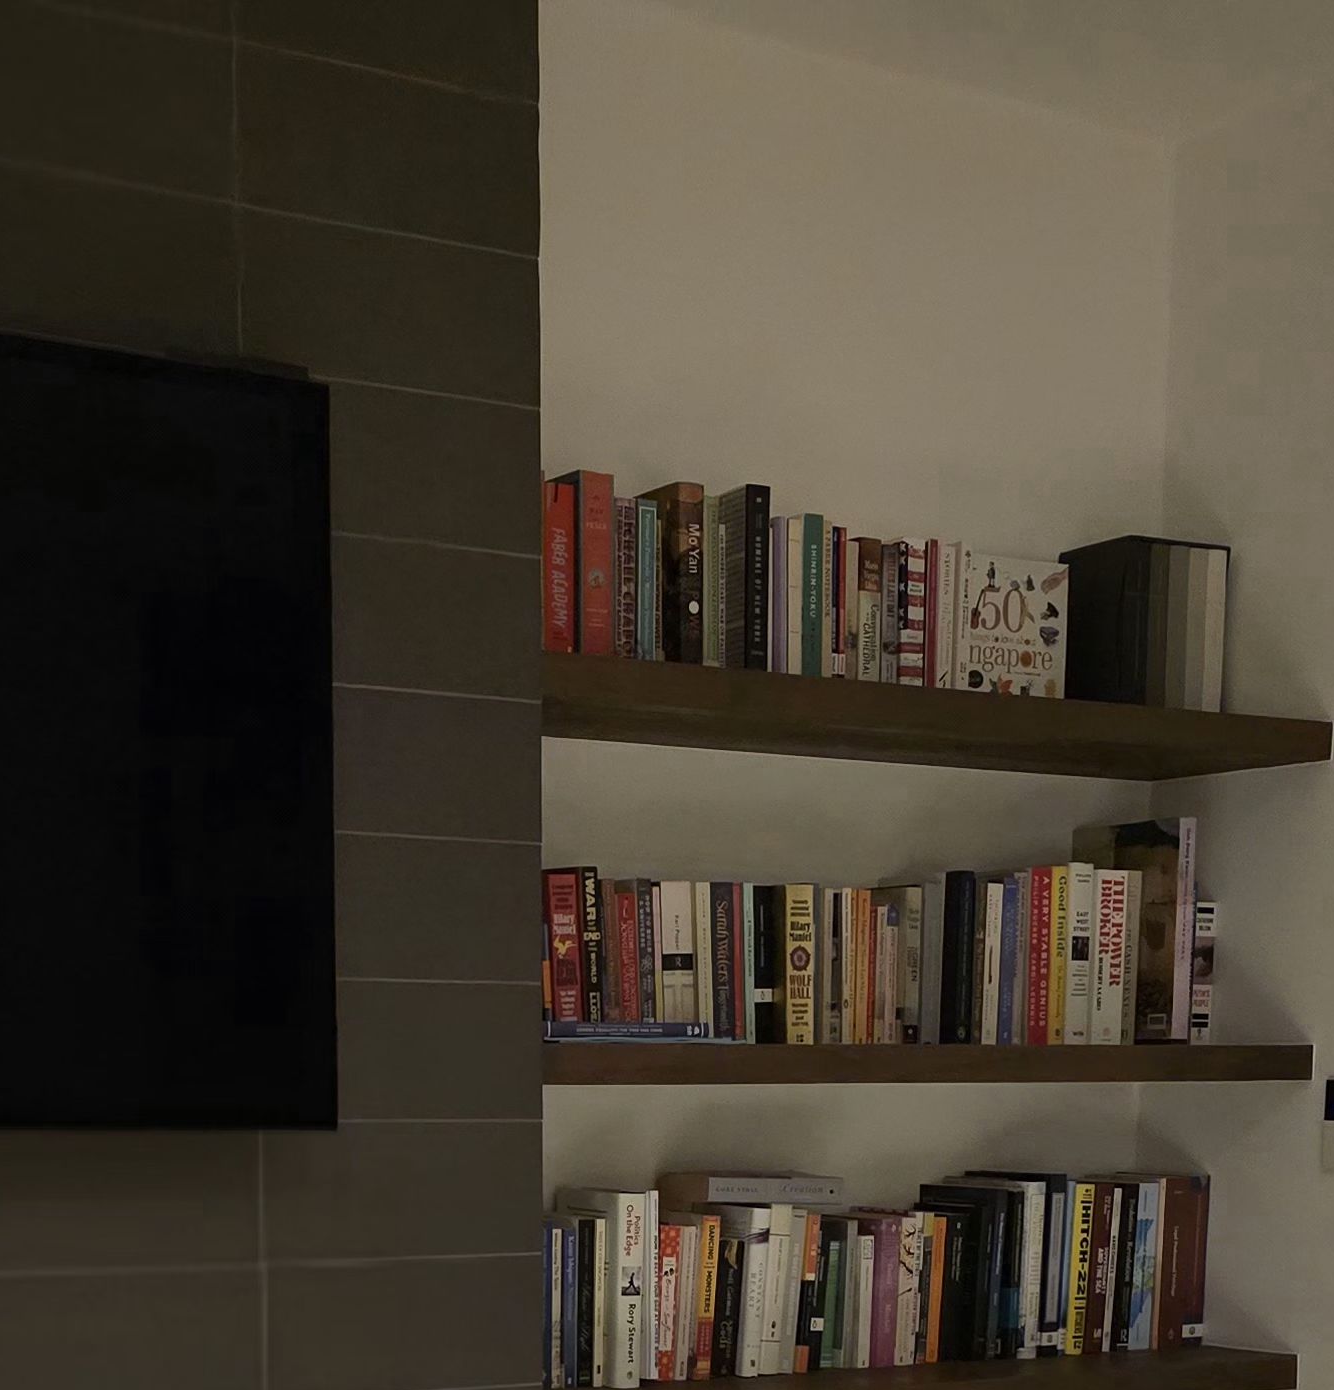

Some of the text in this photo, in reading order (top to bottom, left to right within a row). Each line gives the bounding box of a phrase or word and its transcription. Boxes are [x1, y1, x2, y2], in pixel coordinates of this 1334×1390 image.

[688, 523, 700, 574] Mo Yan
[754, 536, 762, 574] HUMANS
[551, 527, 567, 628] FABER ACADEMY
[754, 579, 762, 590] OF
[809, 544, 817, 619] SHINRIN-YOKU
[754, 595, 762, 615] NEW
[980, 587, 1027, 633] 50
[862, 622, 871, 676] CATHEDRAL
[871, 604, 879, 661] Conversation
[584, 878, 597, 921] WAR
[716, 900, 731, 938] Sarah
[1056, 876, 1067, 958] Good Inside
[1098, 879, 1113, 955] BROKER
[1038, 876, 1050, 1027] A VERY STABLE GENIUS
[1109, 876, 1126, 987] THE POWER
[590, 952, 598, 984] WORLD
[716, 938, 730, 983] Waters
[789, 975, 812, 987] WOLF
[789, 987, 812, 1000] HALL
[1123, 977, 1131, 1018] NEXUS
[624, 1204, 635, 1257] On the Edge
[633, 1216, 641, 1246] Politics
[707, 1225, 715, 1260] DANCING
[1076, 1205, 1093, 1296] HITCH-22
[704, 1270, 713, 1313] MONSTERS
[748, 1272, 757, 1308] HEART
[755, 1262, 764, 1319] CONSTANT
[626, 1303, 636, 1364] Rory Stewart
[720, 1321, 728, 1349] Gods
